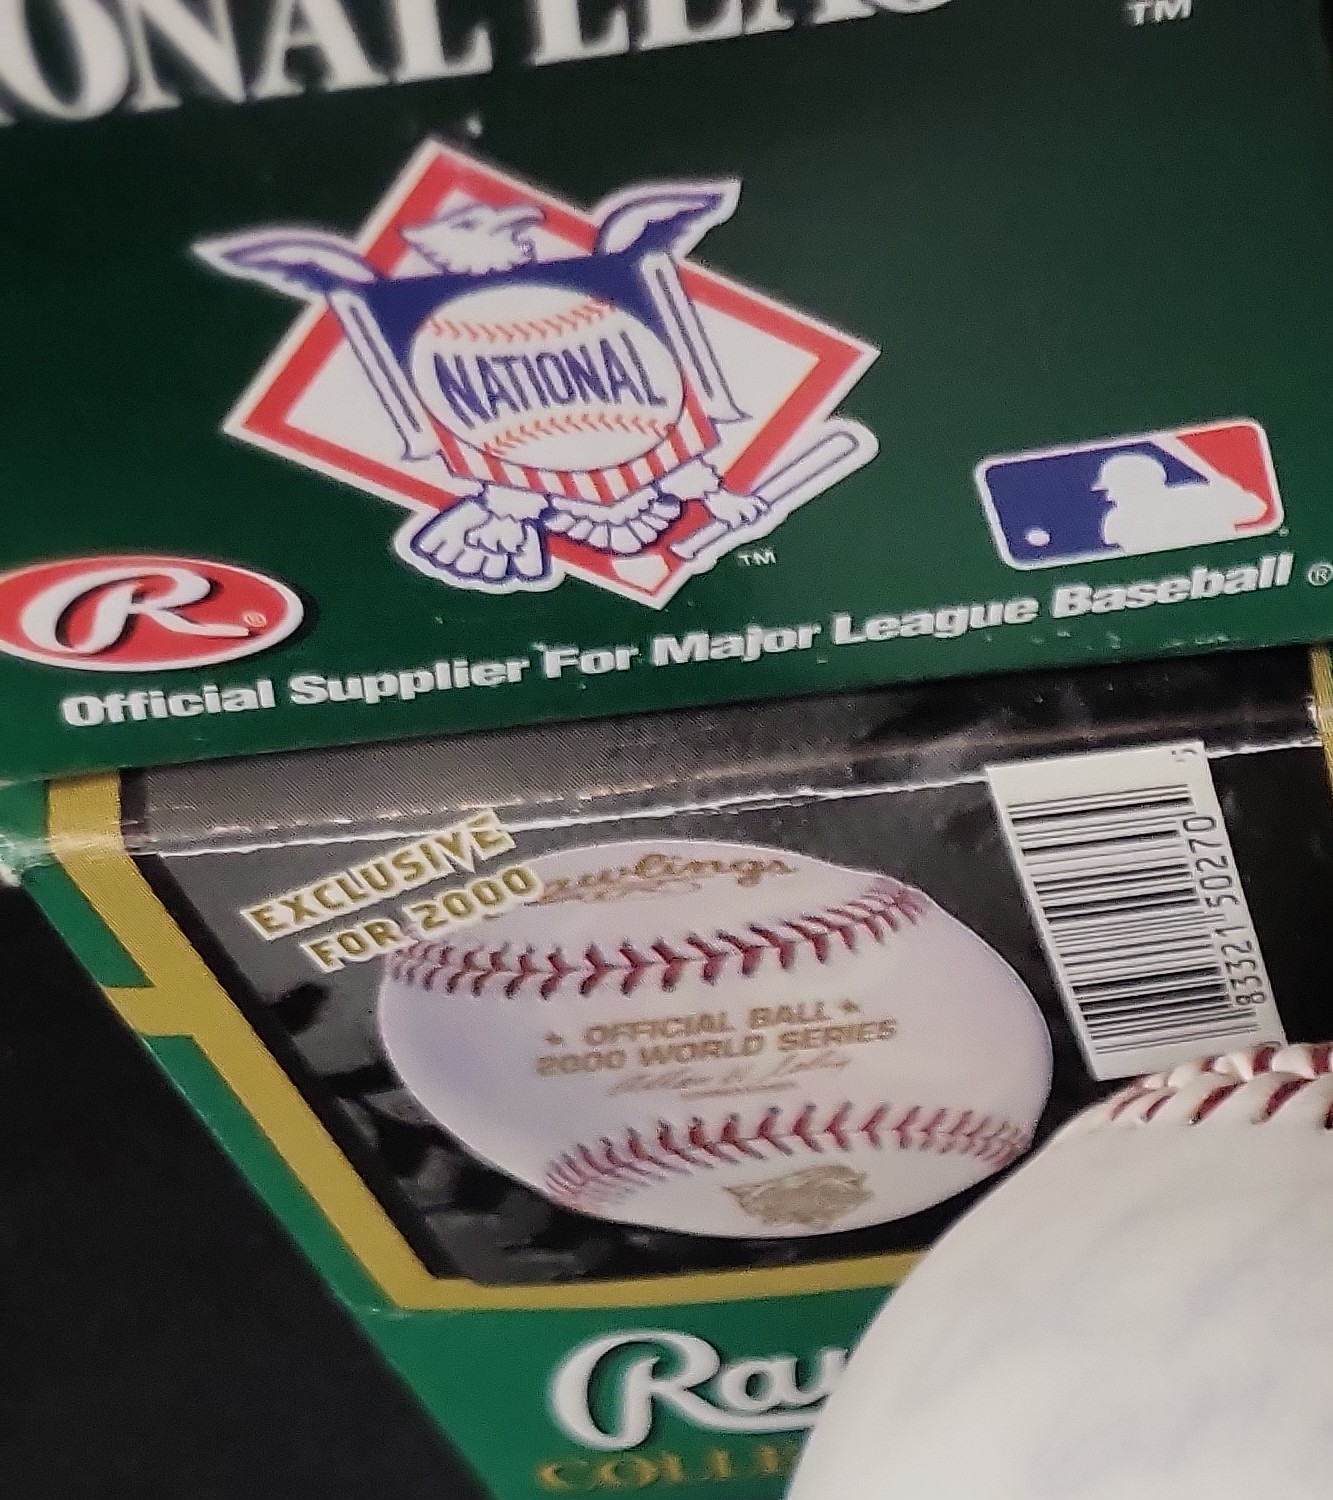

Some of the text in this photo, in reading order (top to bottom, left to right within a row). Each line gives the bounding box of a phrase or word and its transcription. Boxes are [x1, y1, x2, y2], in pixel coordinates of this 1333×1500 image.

[0, 0, 493, 126] ONAL
[432, 329, 667, 431] NATIONAL
[61, 678, 276, 728] Official
[290, 655, 530, 710] Supplier
[545, 645, 640, 679] For
[651, 623, 821, 667] Major
[833, 597, 1040, 646] League
[1051, 552, 1296, 618] Baseball
[248, 812, 510, 936] EXCLUSIVE
[308, 866, 537, 968] FOR 2000
[1182, 815, 1266, 1005] 83321 50270
[637, 1034, 765, 1068] WORLD
[748, 1001, 831, 1030] BALL
